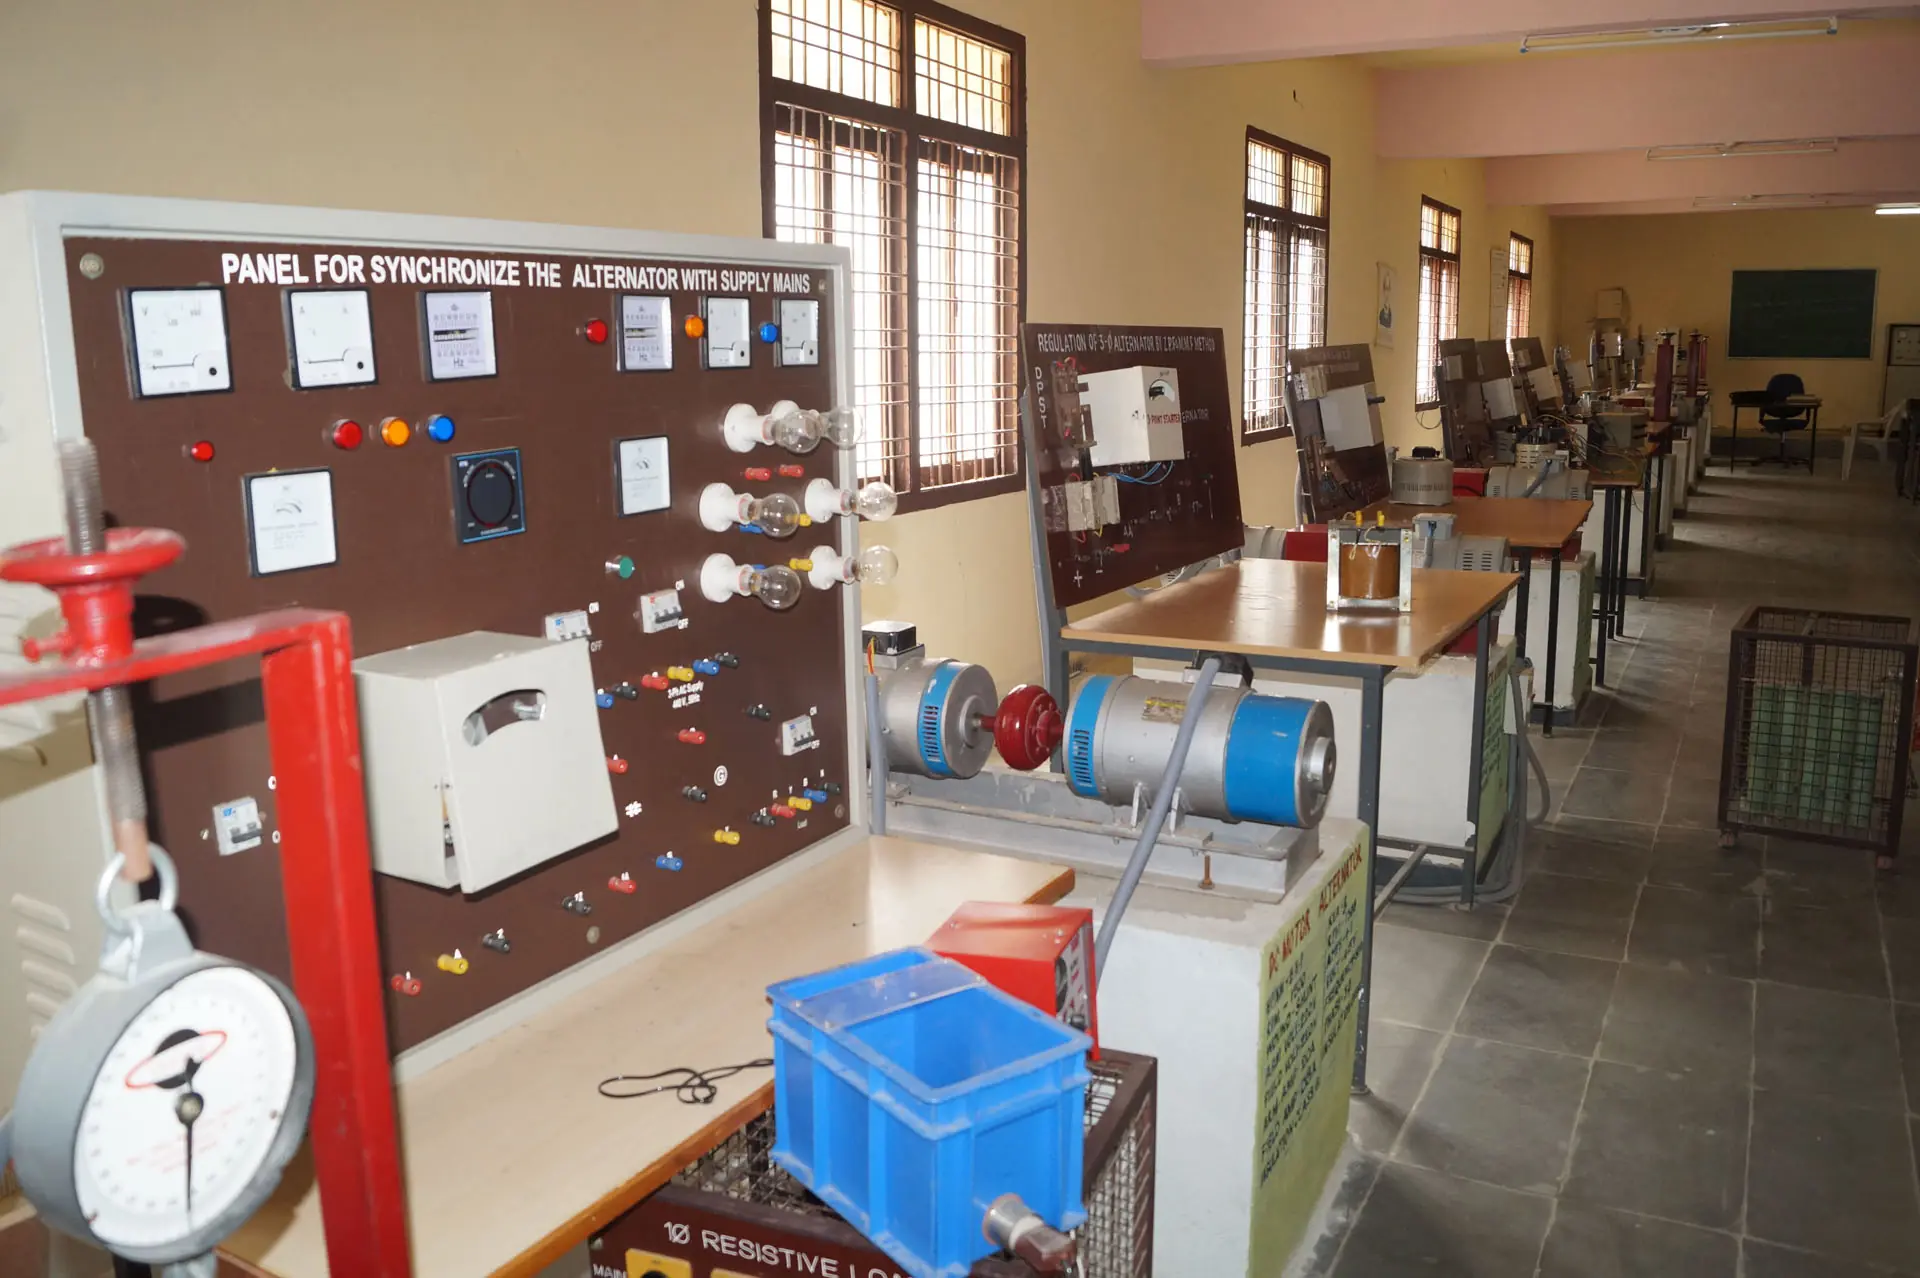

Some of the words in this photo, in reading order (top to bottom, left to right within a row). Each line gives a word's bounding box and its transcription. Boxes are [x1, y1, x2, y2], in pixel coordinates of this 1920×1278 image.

[221, 253, 309, 284] PANEL
[314, 254, 366, 284] FOR
[370, 255, 521, 287] SYNCHRONIZE
[524, 261, 562, 288] THE
[572, 263, 679, 290] ALTERNATOR
[680, 268, 717, 291] WITH
[720, 270, 771, 293] SUPPLY
[772, 272, 811, 294] MAINS
[1037, 333, 1087, 353] REGULATION
[1088, 333, 1098, 352] OF
[1113, 335, 1155, 352] ALTERNATOR
[1319, 843, 1362, 915] ALTERNATOR
[1282, 908, 1311, 962] MOTOR
[701, 1229, 839, 1278] RESISTIVE
